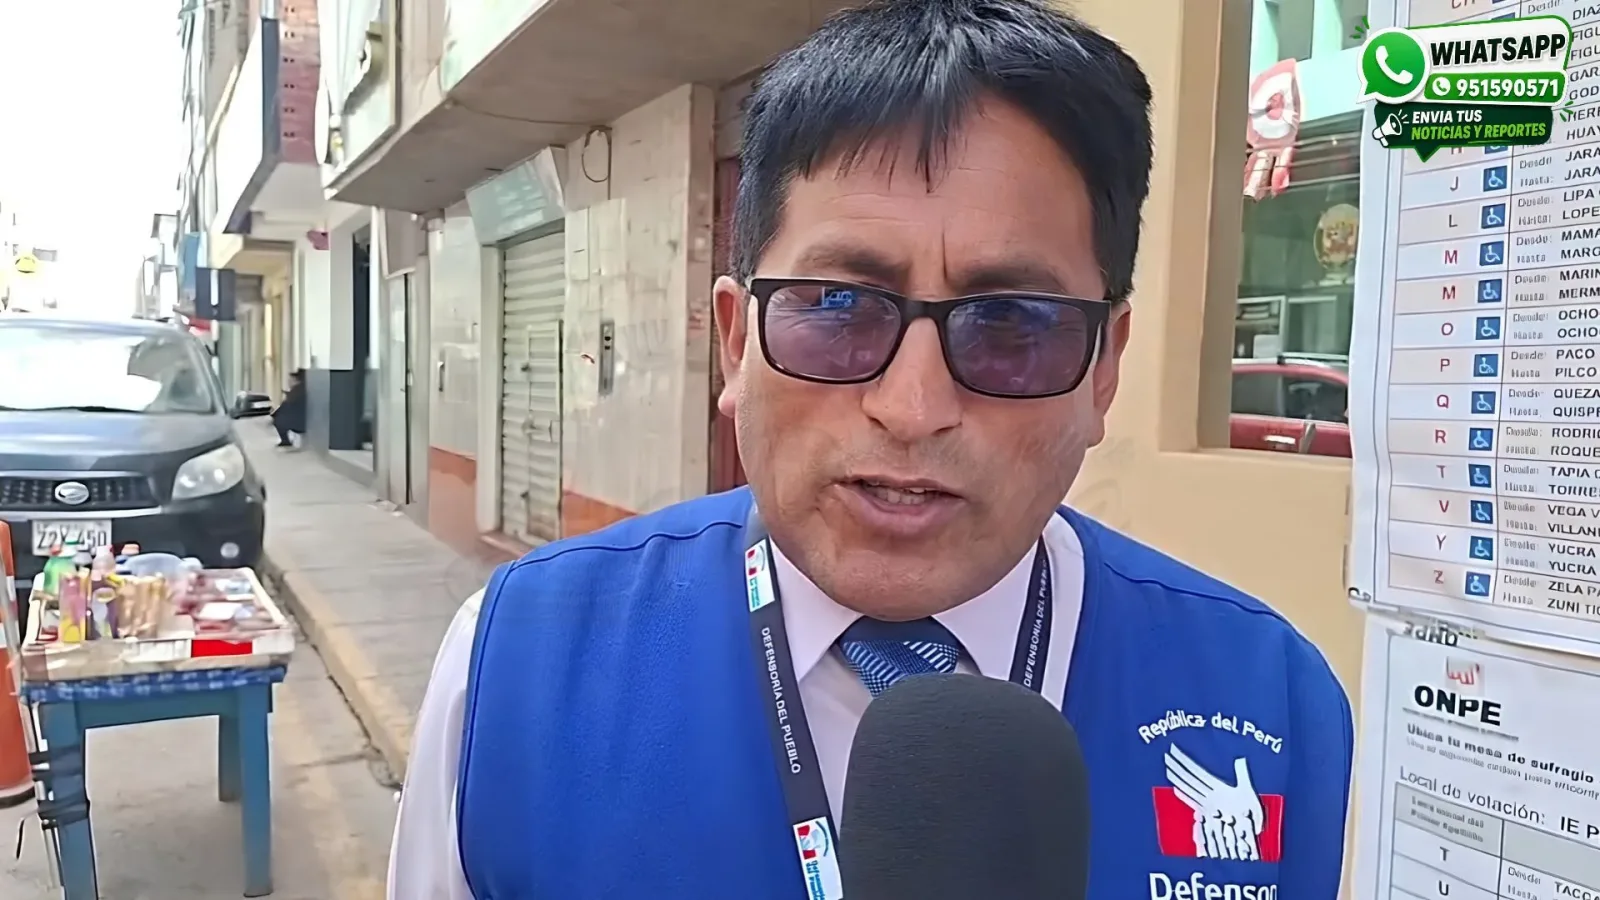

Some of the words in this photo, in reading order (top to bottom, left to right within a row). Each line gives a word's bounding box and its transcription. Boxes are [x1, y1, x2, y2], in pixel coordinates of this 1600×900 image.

[1568, 107, 1600, 122] HER
[1565, 147, 1600, 162] JARA
[1564, 166, 1600, 181] JARA
[1449, 176, 1459, 191] J
[1563, 188, 1595, 202] LIPA
[1562, 206, 1600, 220] LOPE
[1449, 214, 1458, 228] L
[1444, 250, 1458, 265] M
[1442, 285, 1456, 300] M
[1441, 322, 1454, 336] O
[1557, 327, 1600, 338] OCHO
[1556, 348, 1595, 359] PACO
[1440, 358, 1450, 372] P
[1555, 367, 1597, 378] PILCO
[1436, 394, 1450, 409] Q
[1435, 429, 1447, 444] R
[1551, 446, 1600, 457] ROQUE
[1436, 465, 1446, 479] T
[1548, 466, 1590, 478] TAPIA
[1439, 500, 1449, 513] V
[1548, 504, 1586, 517] VEGA
[1548, 522, 1600, 537] VILLAN
[1436, 535, 1447, 550] Y
[1548, 542, 1596, 558] YUCRA
[1548, 560, 1597, 576] YUCRA
[1434, 570, 1444, 584] Z
[1548, 580, 1583, 595] ZELA
[1547, 598, 1580, 613] ZUNI
[1414, 685, 1502, 726] ONPE
[775, 699, 789, 724] DEL
[782, 723, 801, 774] PUEBLO
[1138, 709, 1207, 744] República
[1211, 711, 1239, 734] del
[1242, 720, 1283, 754] Perú
[1531, 759, 1594, 783] sufragio
[1400, 766, 1437, 792] Local
[1561, 816, 1580, 835] IE
[1439, 847, 1450, 861] T
[1438, 880, 1449, 896] U
